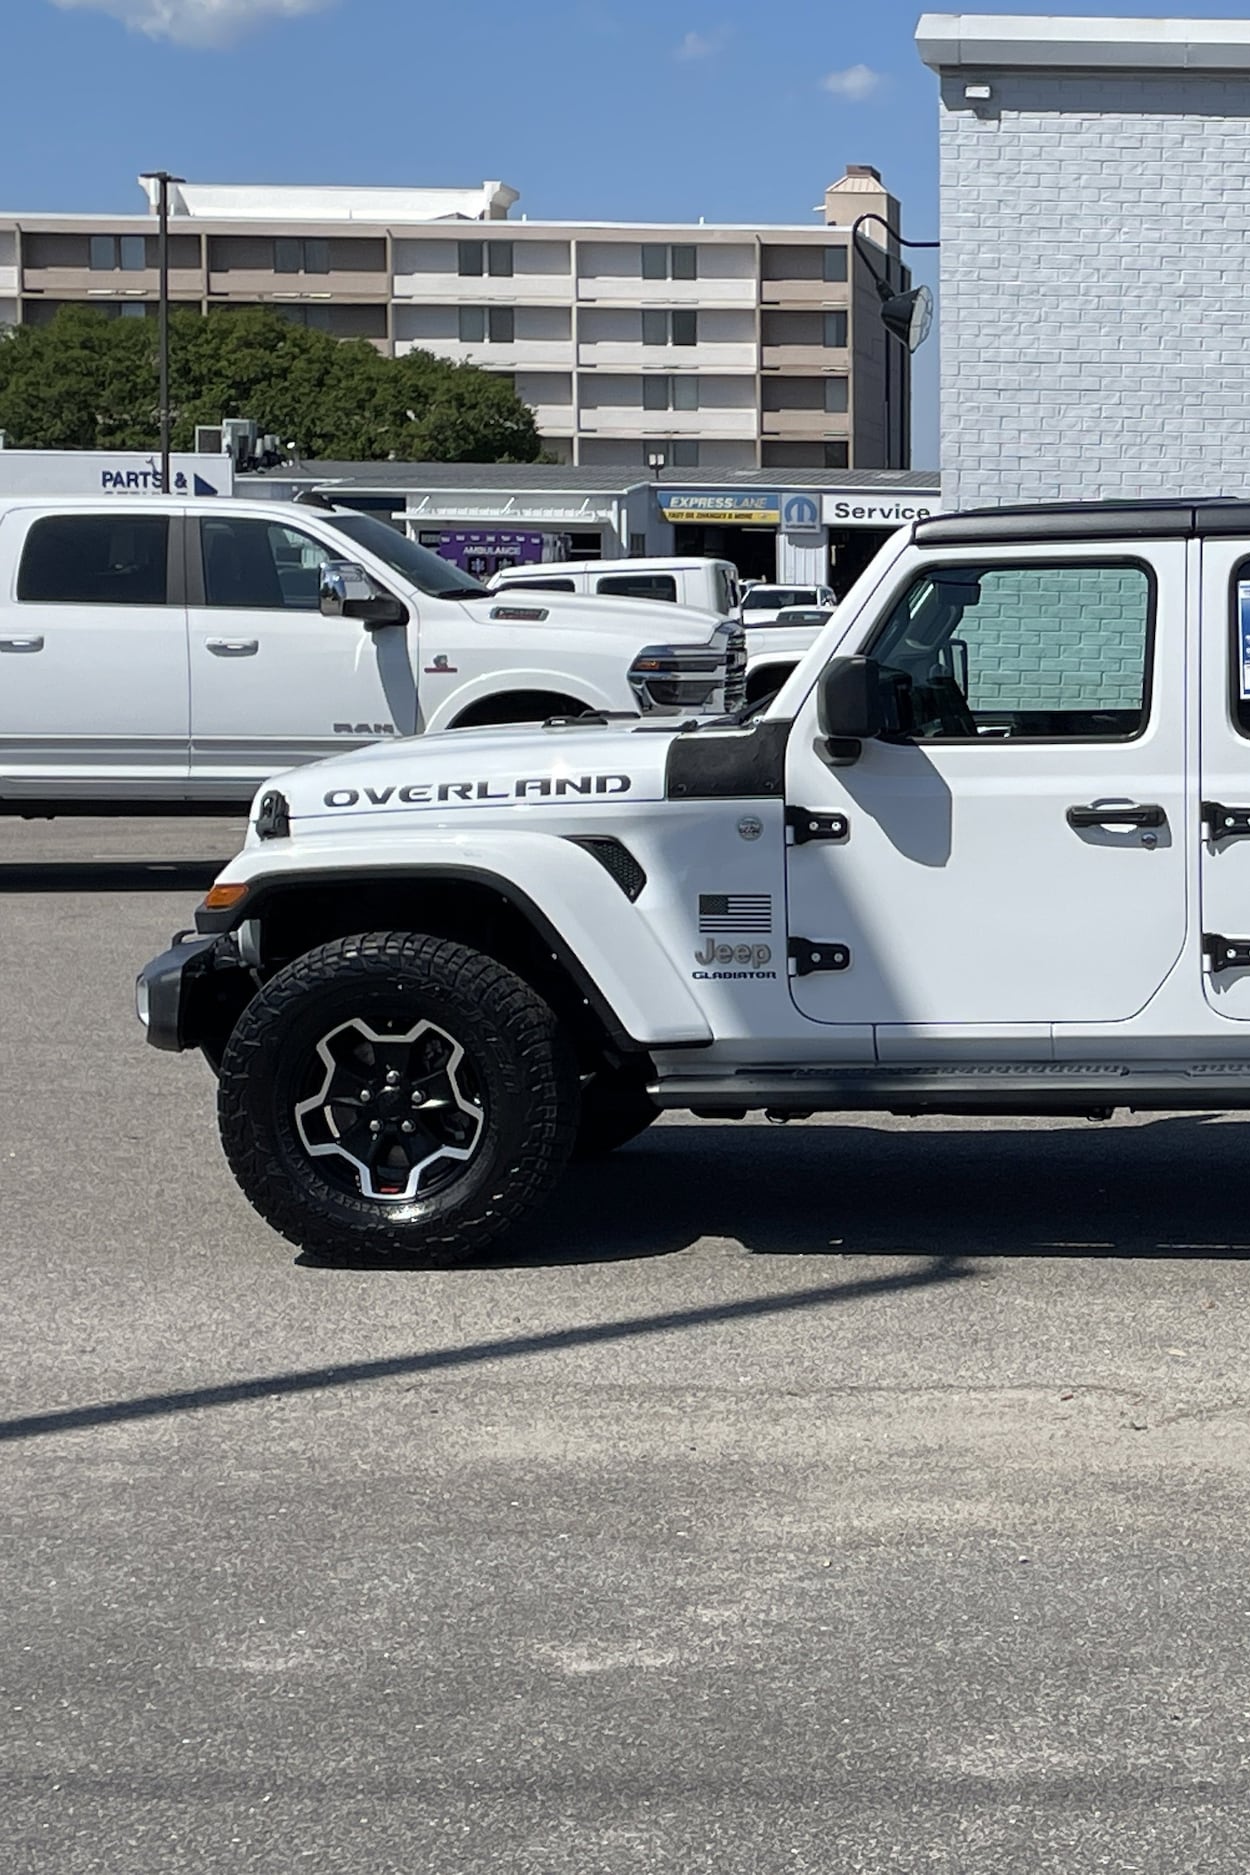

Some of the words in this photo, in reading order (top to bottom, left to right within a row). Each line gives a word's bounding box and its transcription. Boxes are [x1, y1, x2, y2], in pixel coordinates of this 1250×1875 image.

[102, 471, 162, 489] PARTS
[174, 471, 188, 489] &
[834, 502, 931, 520] Service
[463, 546, 521, 556] AMBULANCE
[333, 723, 395, 735] RAM
[322, 774, 632, 808] OVERLAND
[694, 937, 773, 970] Jeep
[692, 971, 777, 981] GLADIATOR
